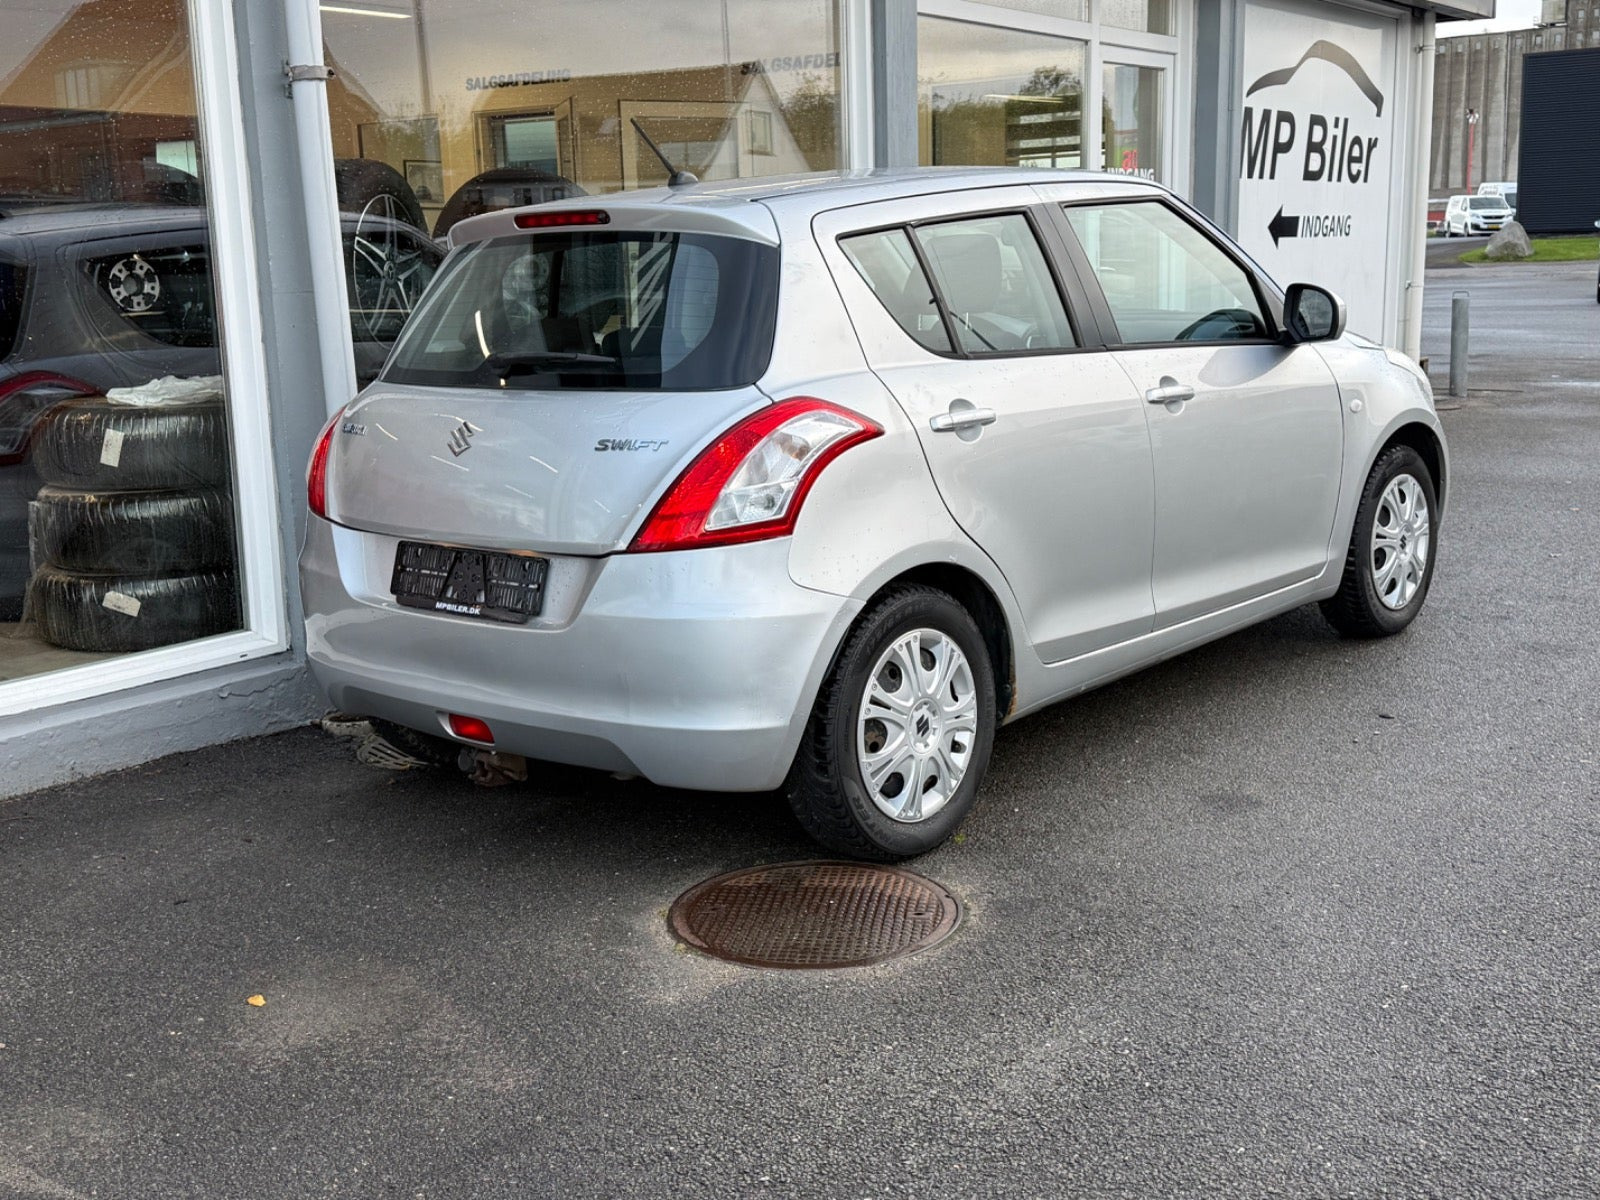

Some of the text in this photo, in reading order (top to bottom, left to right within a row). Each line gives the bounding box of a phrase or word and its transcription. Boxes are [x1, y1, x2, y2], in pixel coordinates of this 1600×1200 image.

[465, 68, 572, 92] SALGSAFDELING
[1239, 106, 1379, 184] MP Biler
[1300, 214, 1352, 238] INDGANG
[594, 438, 669, 452] SWIFT
[435, 601, 481, 615] MPBILER.DK
